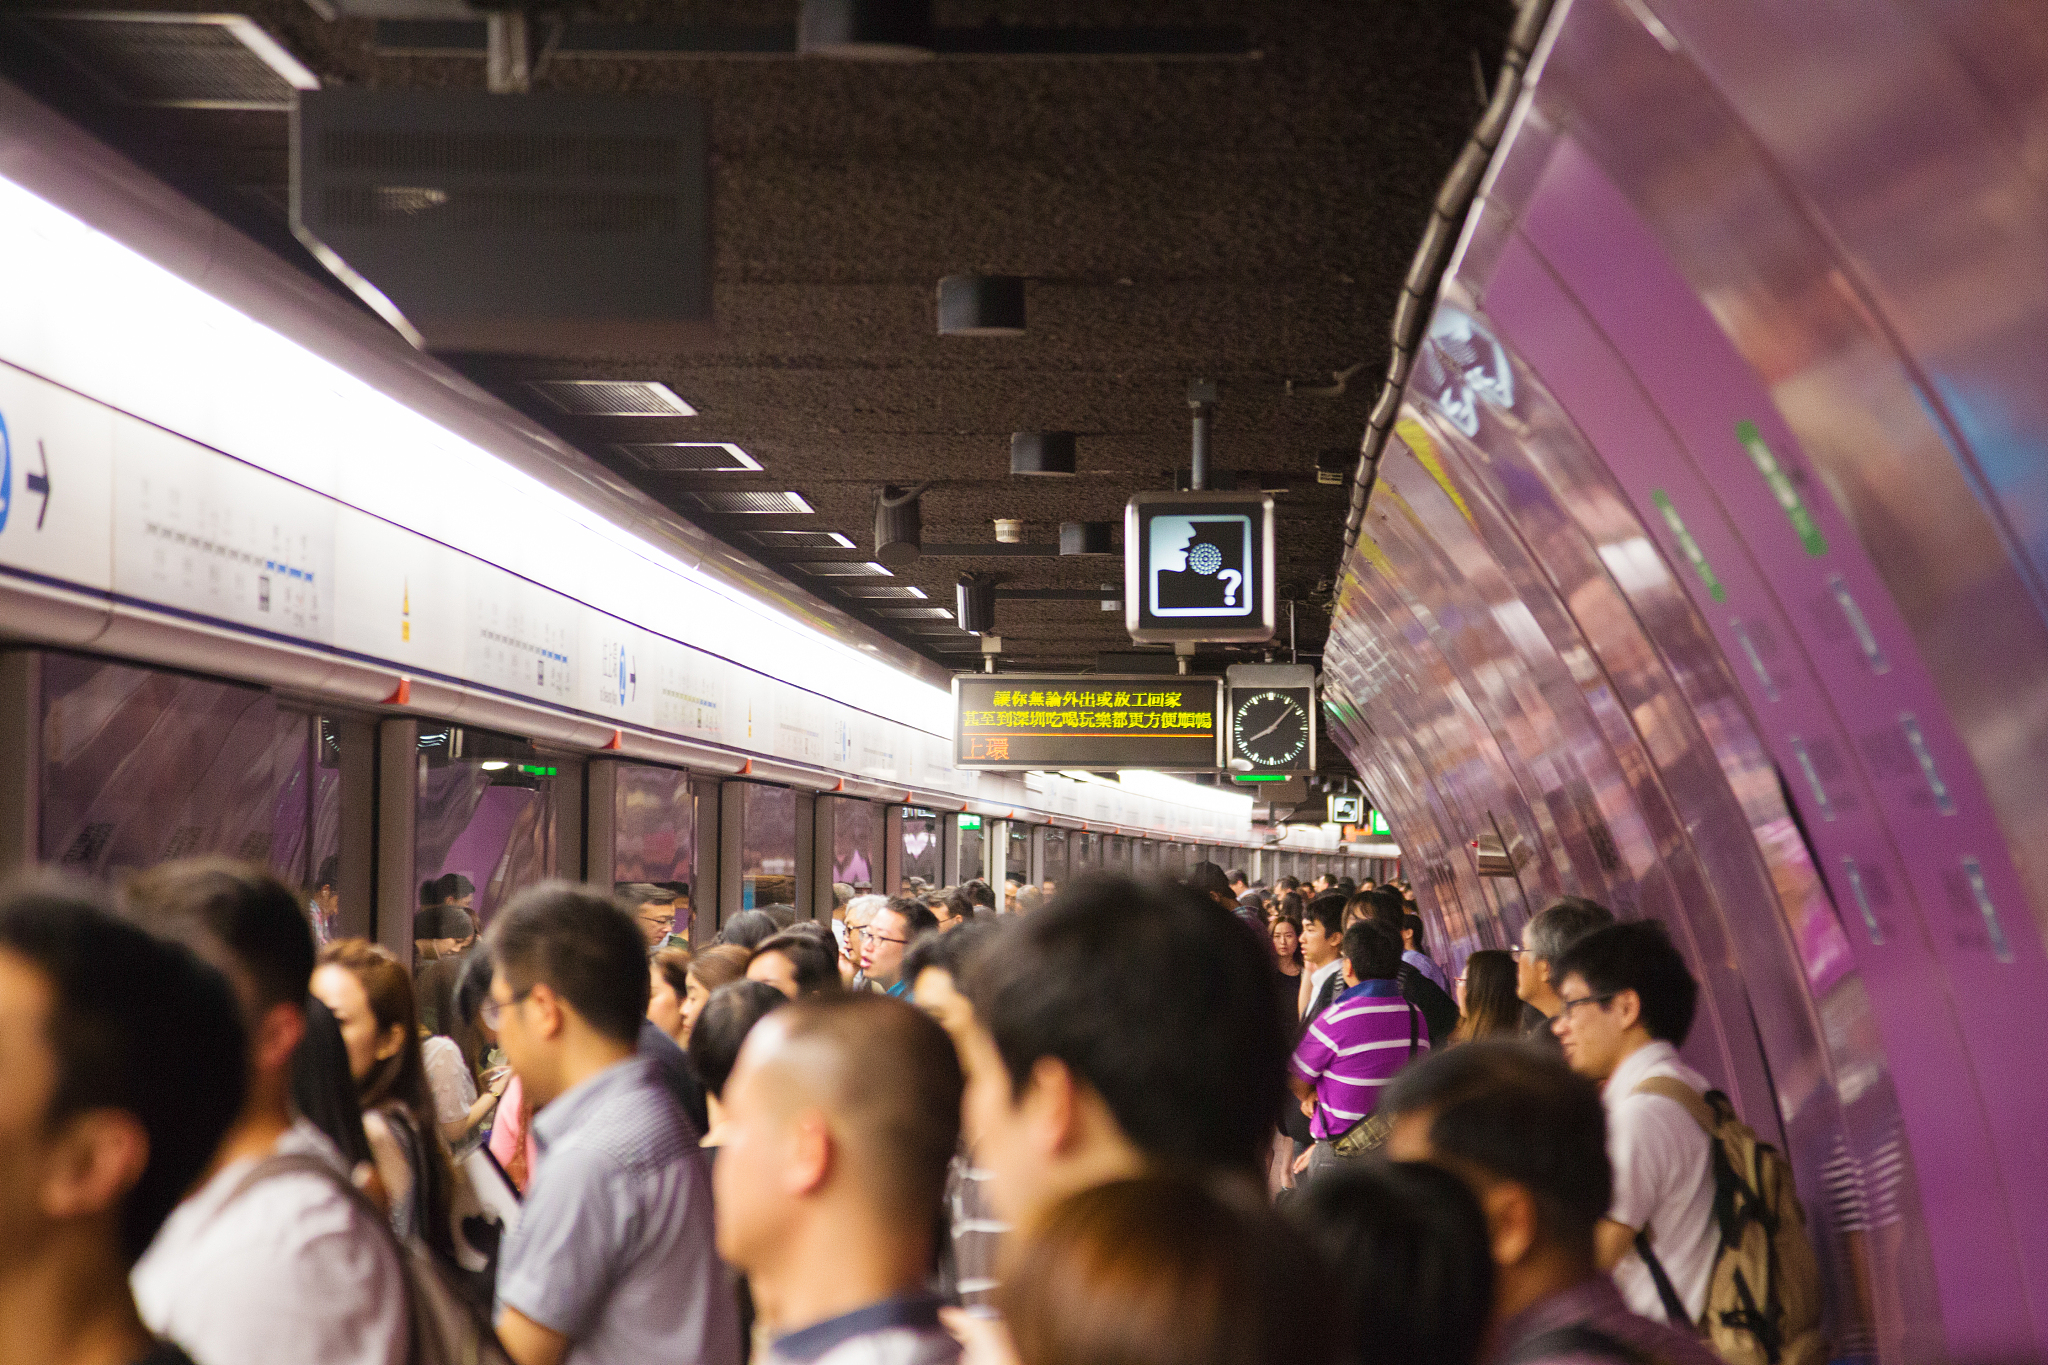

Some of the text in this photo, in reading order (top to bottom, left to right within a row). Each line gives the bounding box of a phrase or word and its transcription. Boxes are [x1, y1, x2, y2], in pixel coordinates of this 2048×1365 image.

[993, 691, 1182, 708] 讓你無論外出或放工回家
[963, 710, 1212, 729] 甚至到深圳吃喝玩樂都更方便順暢
[962, 737, 1010, 760] 上環
